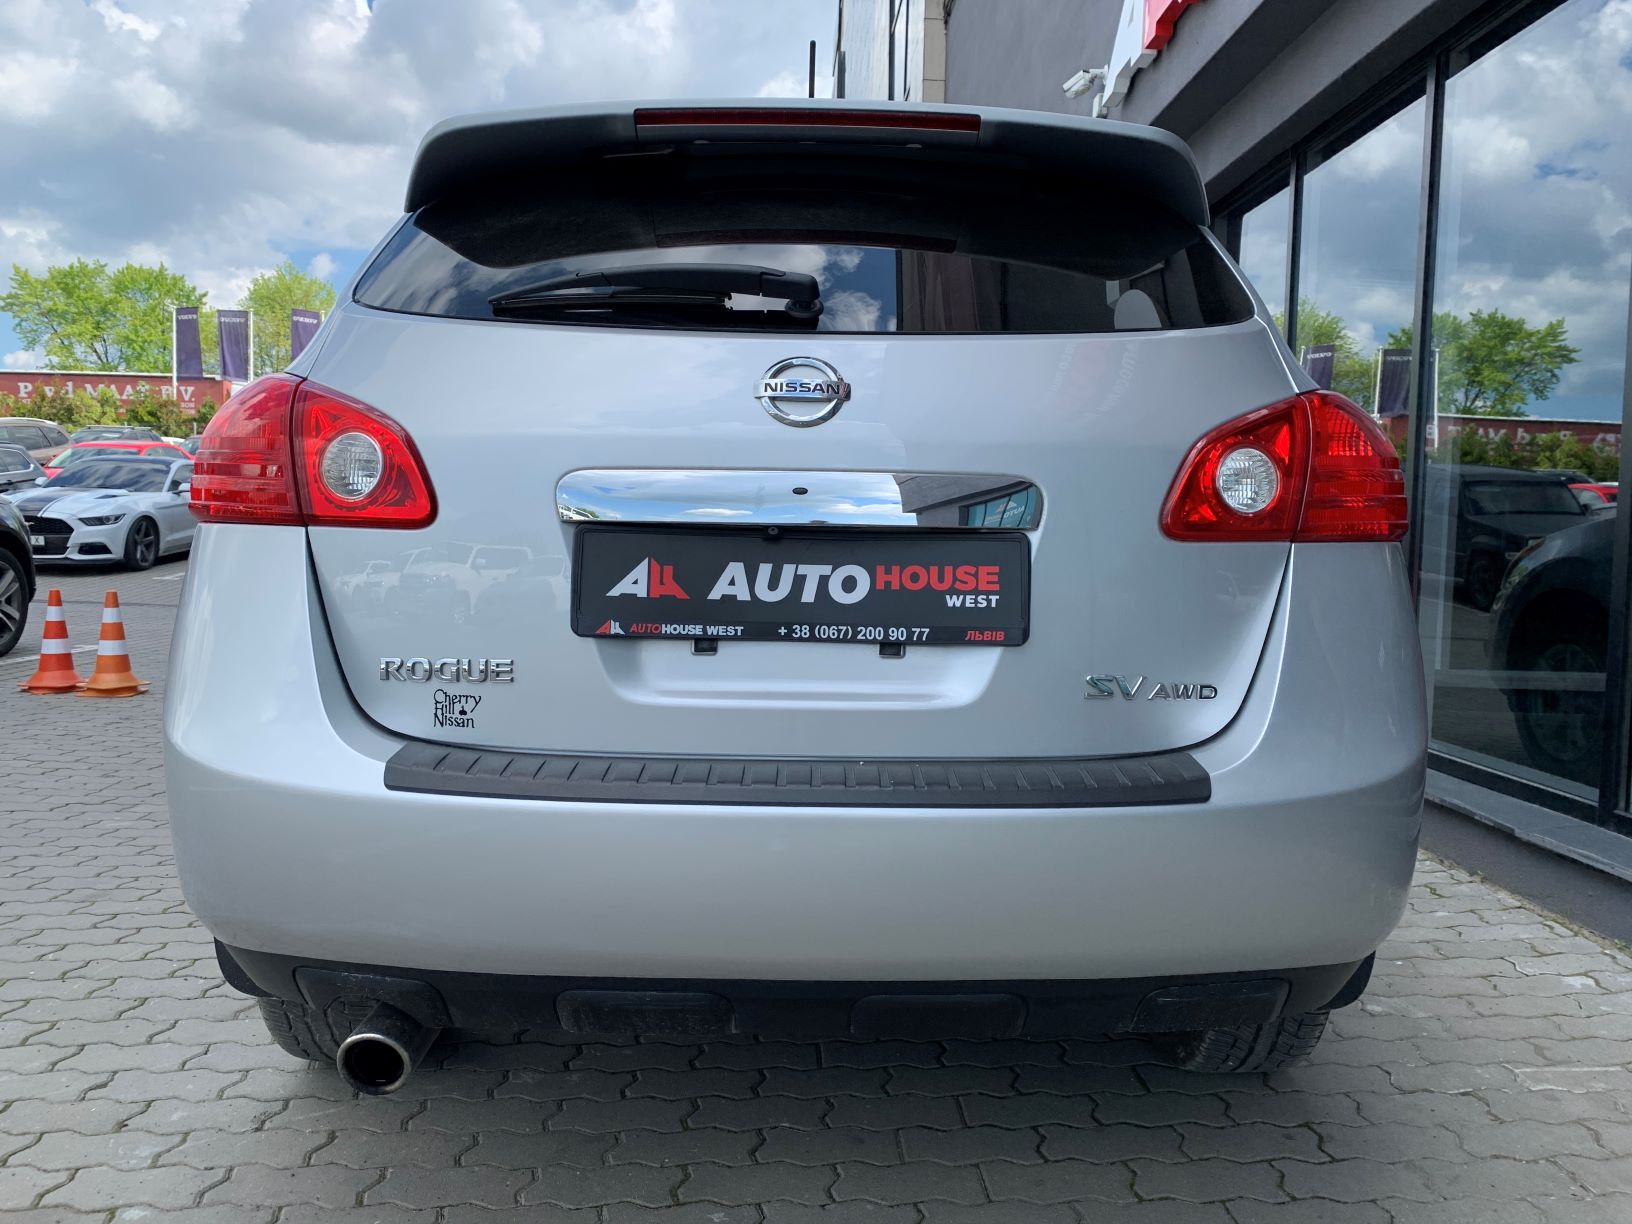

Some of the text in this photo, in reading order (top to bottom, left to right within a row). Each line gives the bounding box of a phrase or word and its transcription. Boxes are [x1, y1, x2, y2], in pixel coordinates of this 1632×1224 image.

[764, 382, 839, 395] NISSAN
[706, 561, 1000, 605] AUTO HOUSE
[946, 594, 1000, 608] WEST
[629, 623, 744, 636] AUTOHOUSE WEST
[792, 625, 810, 638] 38
[814, 624, 852, 639] (067)
[857, 626, 884, 640] 200
[888, 627, 907, 641] 90
[911, 627, 930, 641] 77
[965, 630, 1005, 641] ЛЬВІВ
[379, 657, 514, 684] ROGUE
[1084, 675, 1218, 700] SV AWD
[433, 688, 482, 713] Cherry
[434, 700, 455, 715] Hill
[434, 713, 475, 729] Nissan
